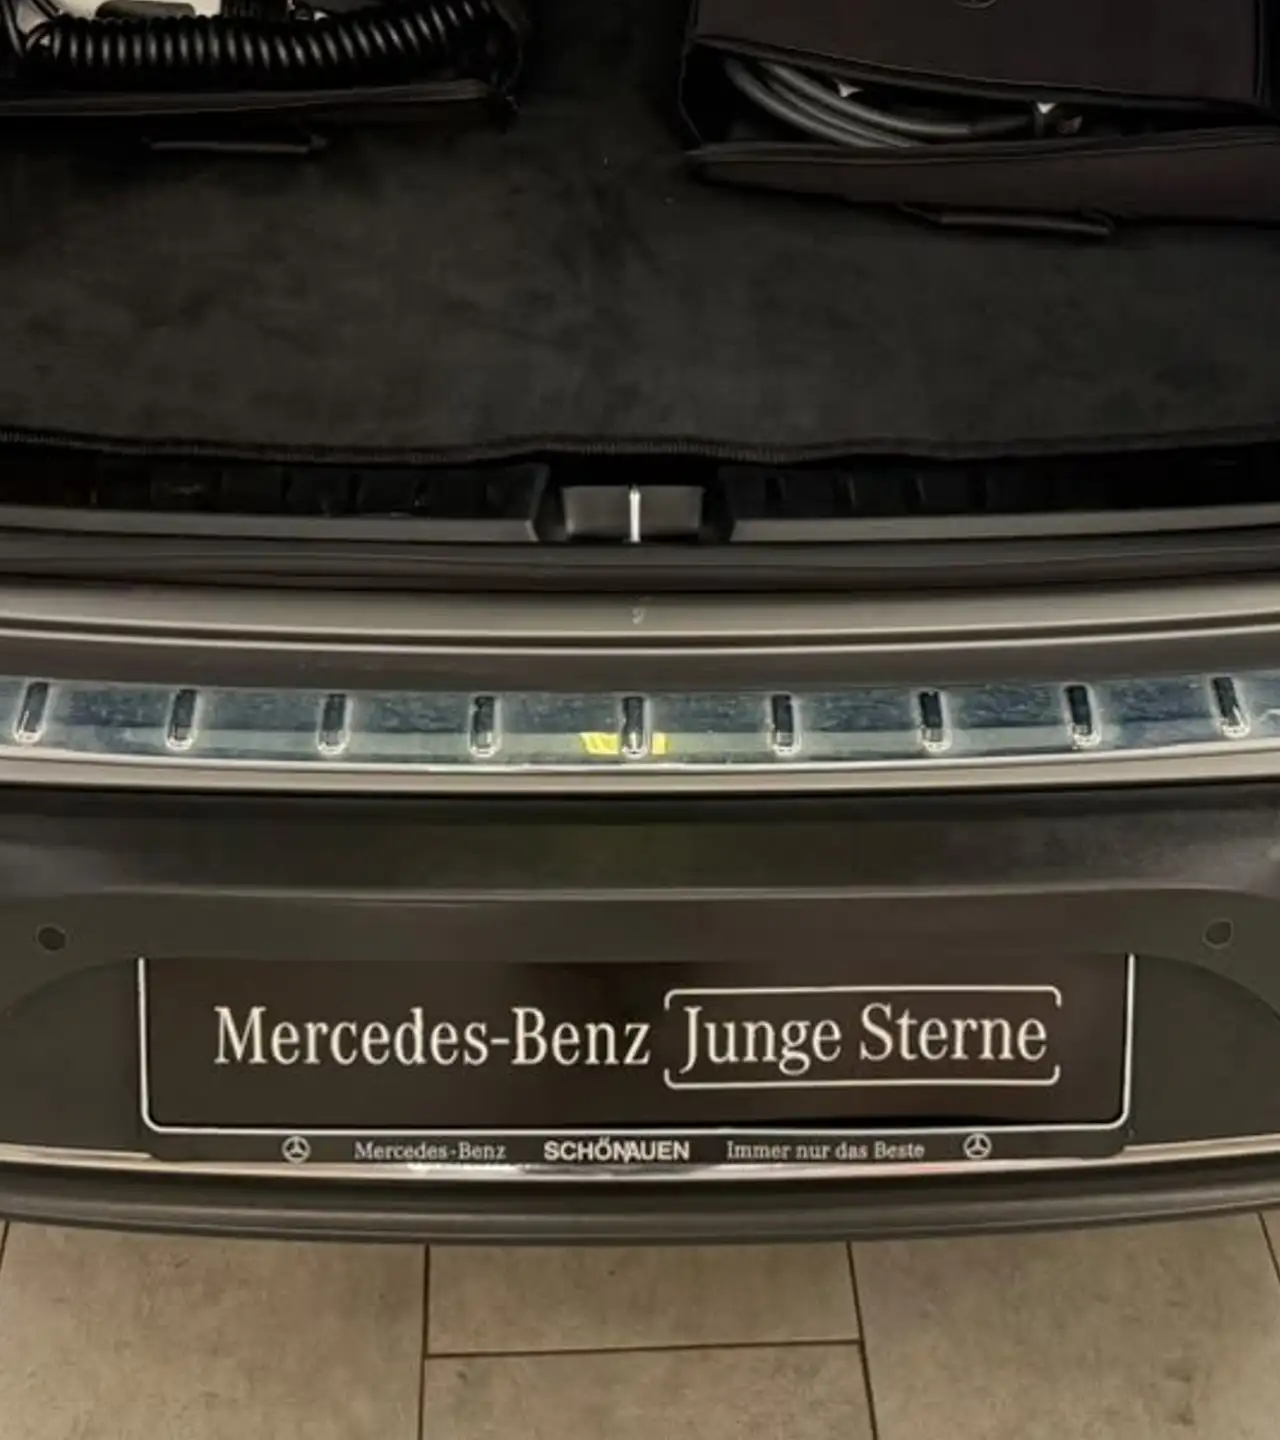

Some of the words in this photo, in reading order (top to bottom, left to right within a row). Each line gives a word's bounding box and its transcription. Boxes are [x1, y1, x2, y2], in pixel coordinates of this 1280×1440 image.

[213, 1005, 651, 1066] Mercedes-Benz
[678, 1005, 842, 1076] Junge
[859, 1002, 1048, 1062] Sterne
[354, 1141, 507, 1160] Mercedes-Benz
[543, 1136, 690, 1163] SCHÖNAUEN
[726, 1140, 792, 1160] Immer
[796, 1144, 833, 1160] nur
[834, 1140, 869, 1160] das
[874, 1140, 926, 1160] Beste
